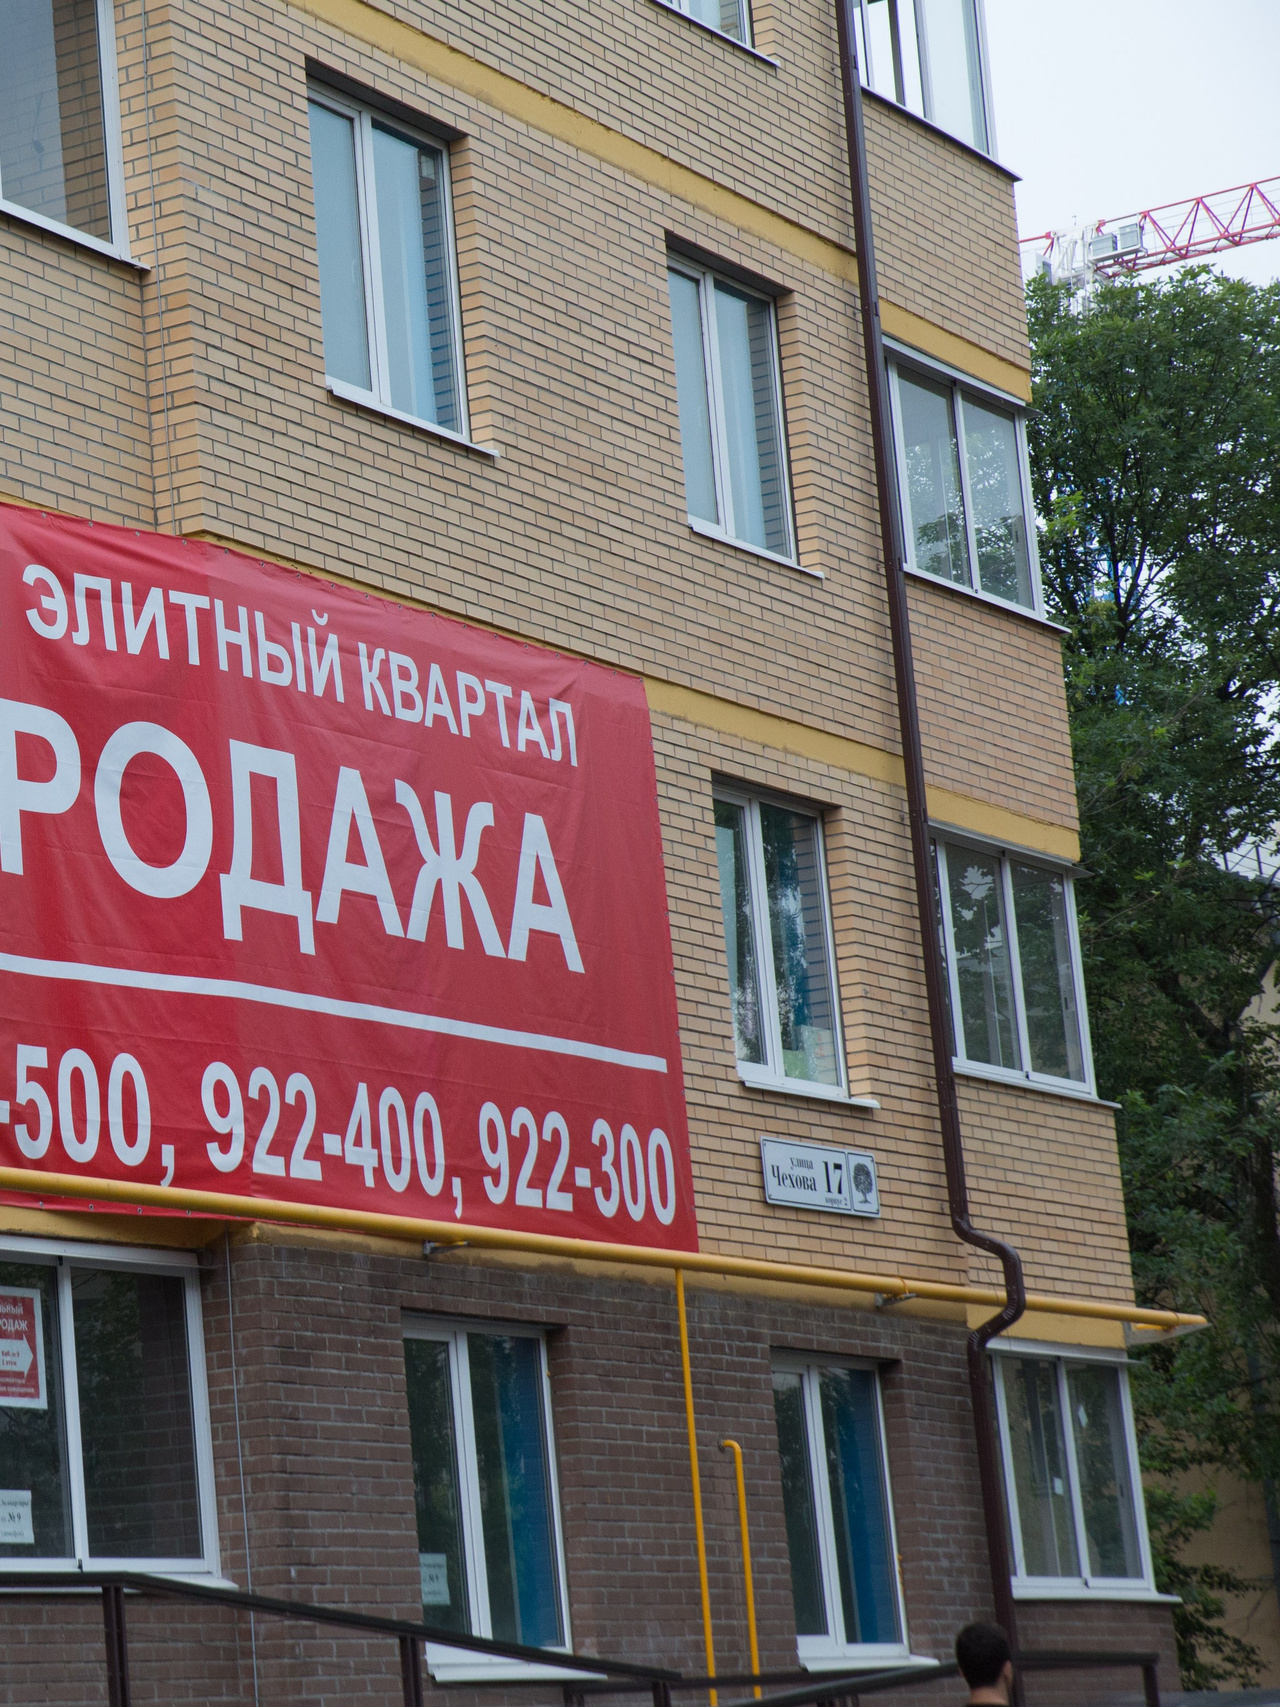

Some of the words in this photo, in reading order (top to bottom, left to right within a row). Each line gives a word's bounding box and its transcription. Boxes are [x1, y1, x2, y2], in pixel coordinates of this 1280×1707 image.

[25, 563, 344, 698] ЭЛИТНЫЙ
[359, 642, 578, 767] КВАРТАЛ
[200, 1060, 463, 1218] 922-400,
[477, 1100, 677, 1227] 922-300
[770, 1164, 818, 1192] Чехова
[821, 1160, 843, 1195] 17
[790, 1157, 814, 1170] улица
